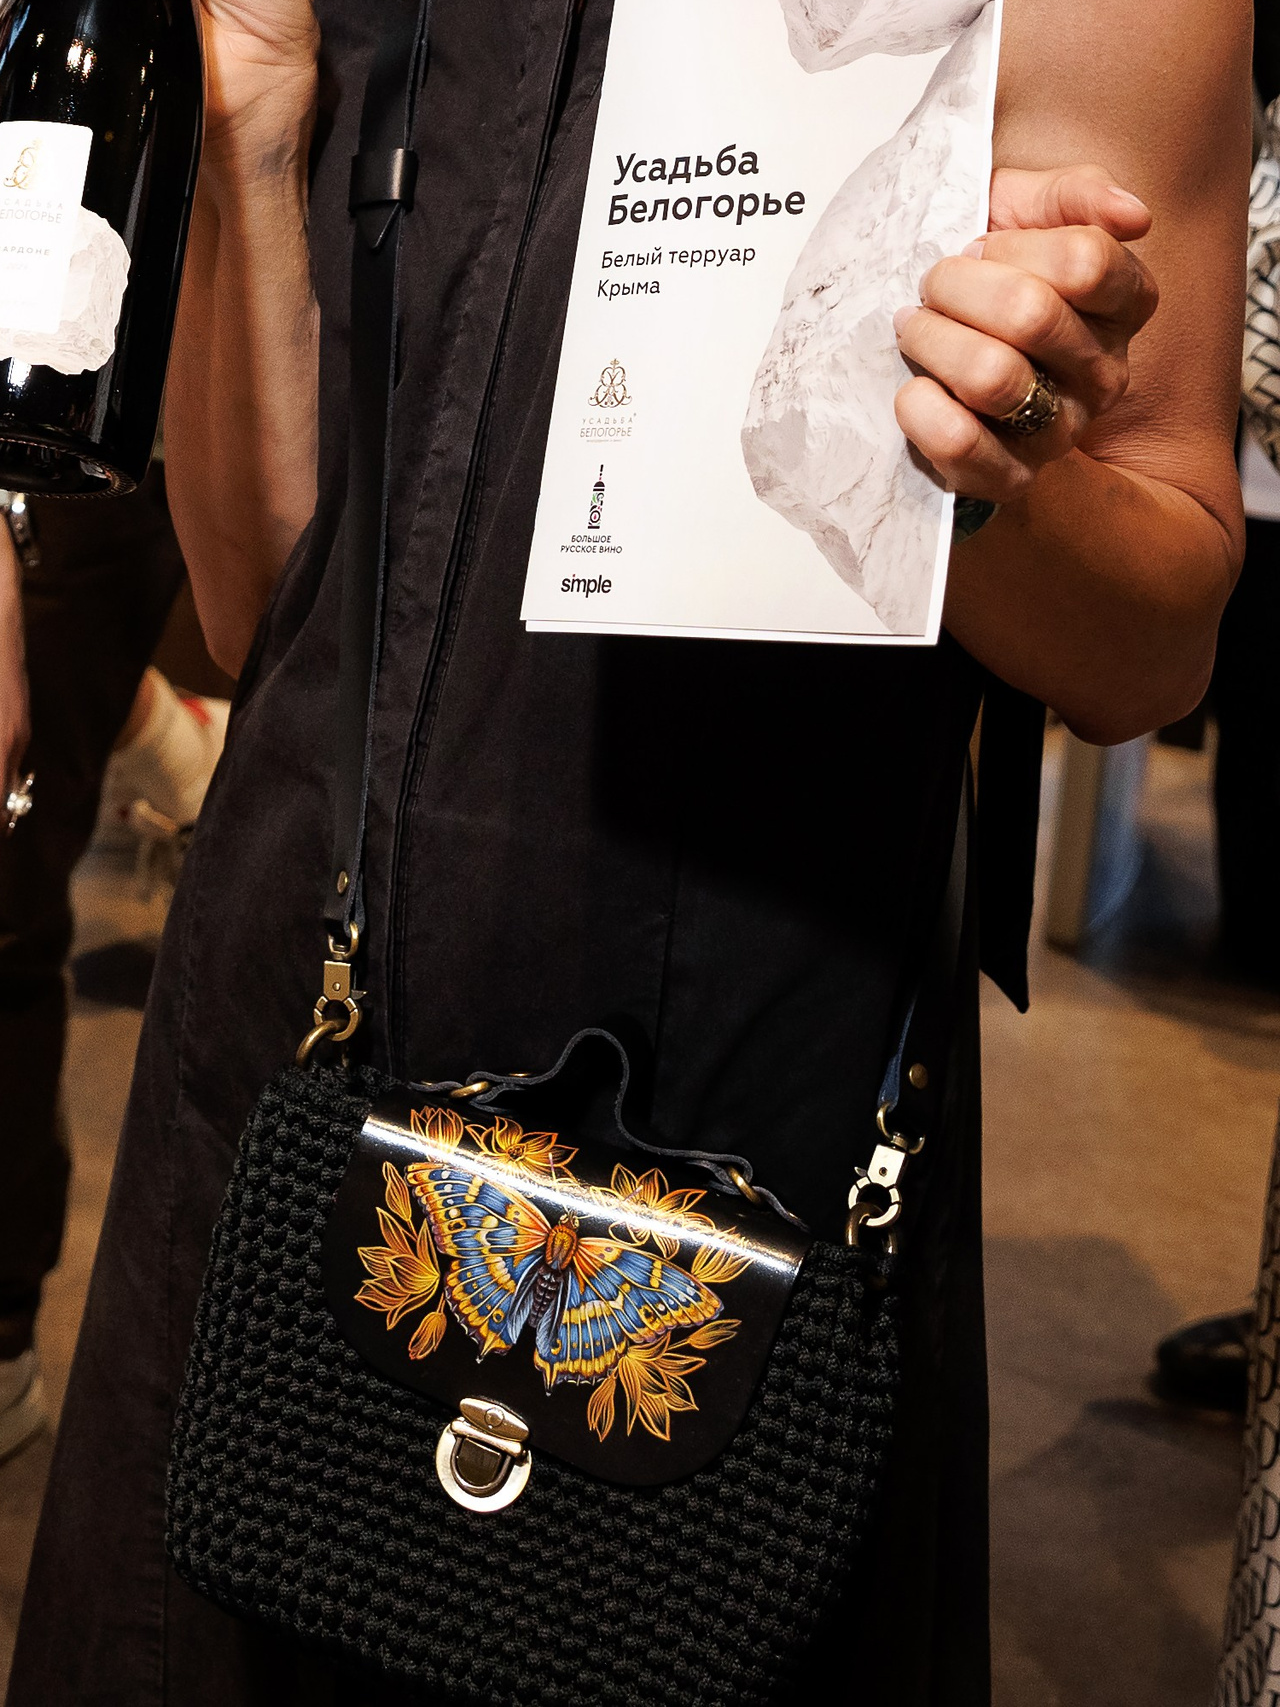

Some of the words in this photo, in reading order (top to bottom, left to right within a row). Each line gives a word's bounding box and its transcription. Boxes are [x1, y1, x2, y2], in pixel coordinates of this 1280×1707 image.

[613, 144, 759, 185] Усадьба
[608, 191, 806, 225] Белогорье
[601, 247, 662, 269] Белый
[669, 248, 756, 268] терруар
[597, 279, 661, 301] Крыма
[582, 416, 634, 425] УСАДЬБА
[580, 427, 633, 438] БЕЛОГОРЬЕ
[560, 545, 597, 553] РУССКОЕ
[599, 546, 623, 554] ВИНО
[571, 535, 612, 543] БОЛЬШОЕ
[561, 574, 612, 598] simple
